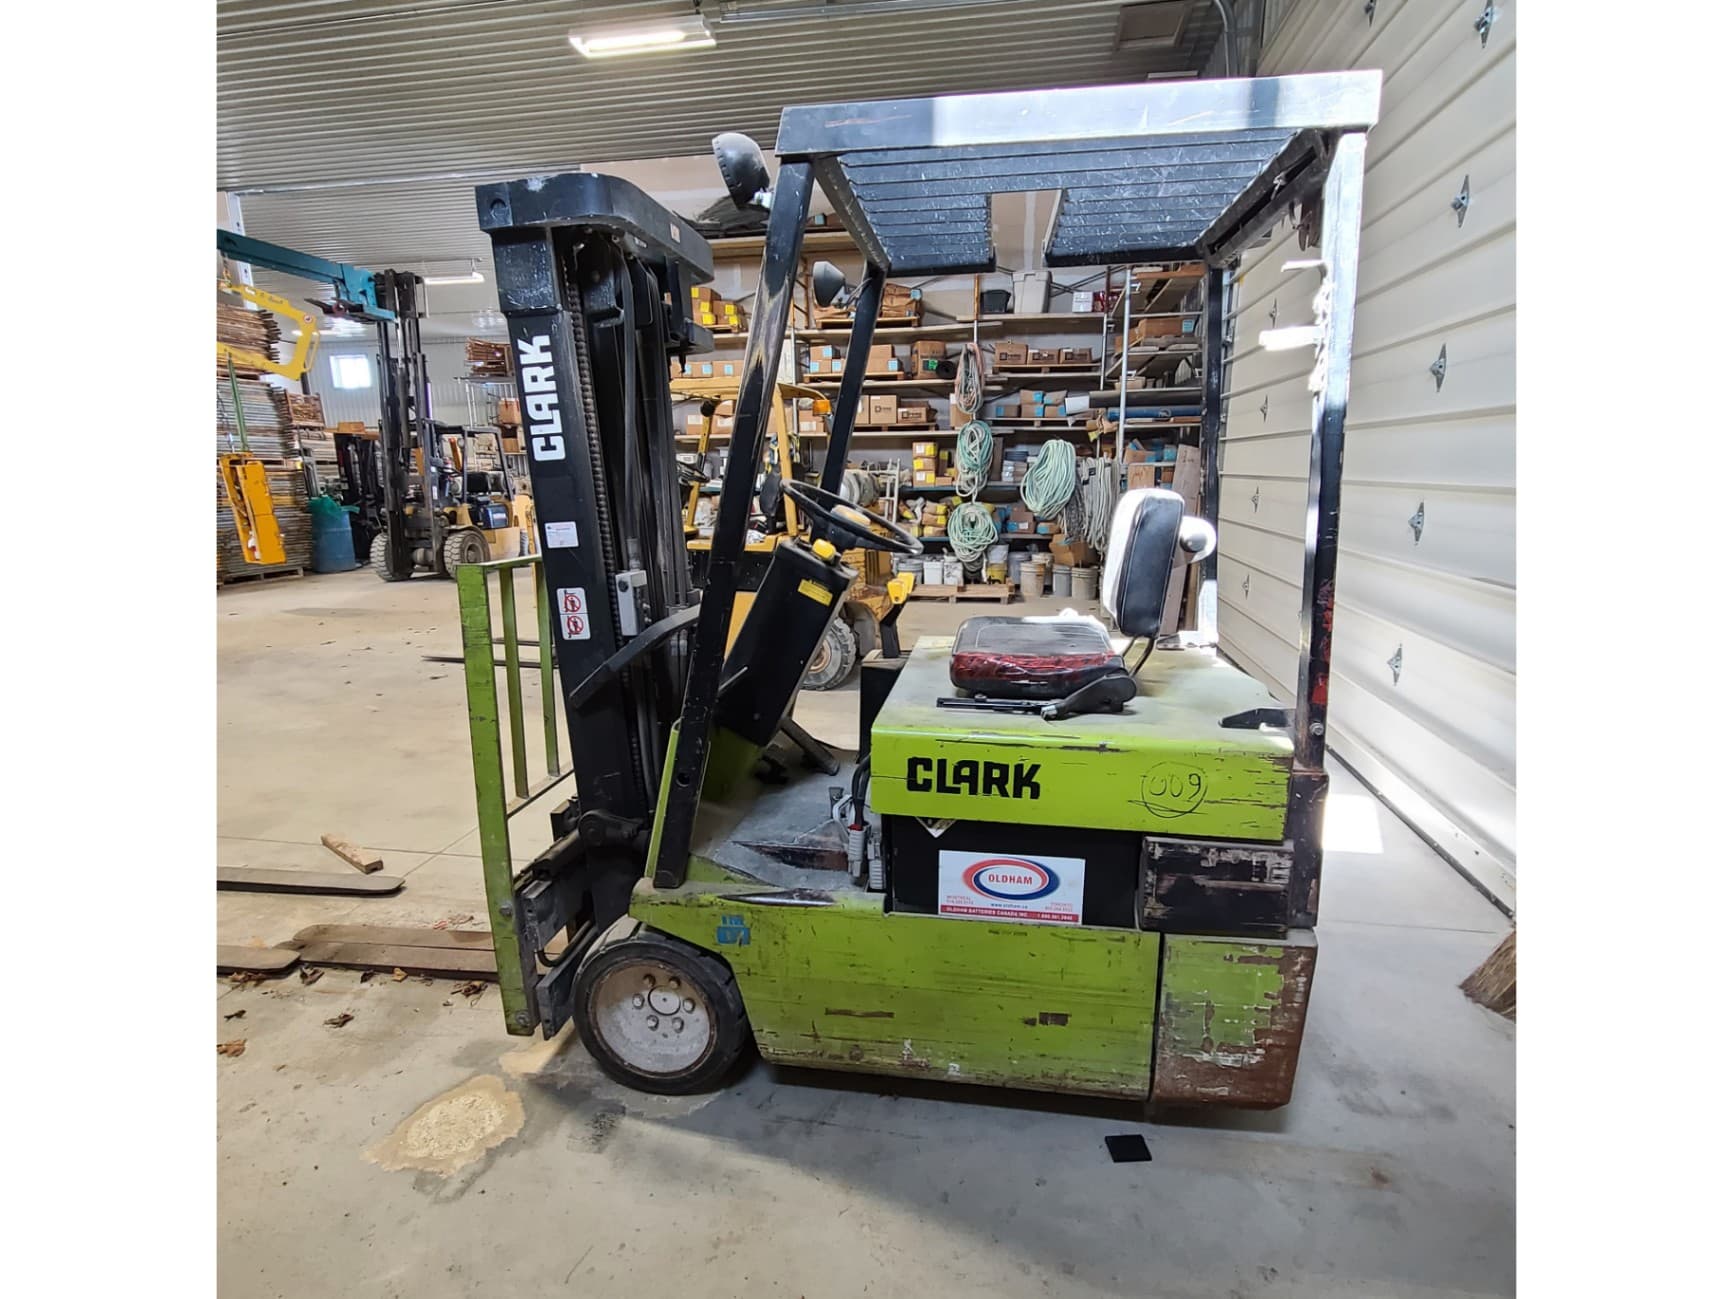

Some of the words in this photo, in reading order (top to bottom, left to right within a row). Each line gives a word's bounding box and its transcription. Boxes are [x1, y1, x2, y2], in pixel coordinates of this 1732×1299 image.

[517, 334, 566, 462] CLARK
[906, 756, 1041, 800] CLARK
[988, 874, 1033, 885] OLDHAM
